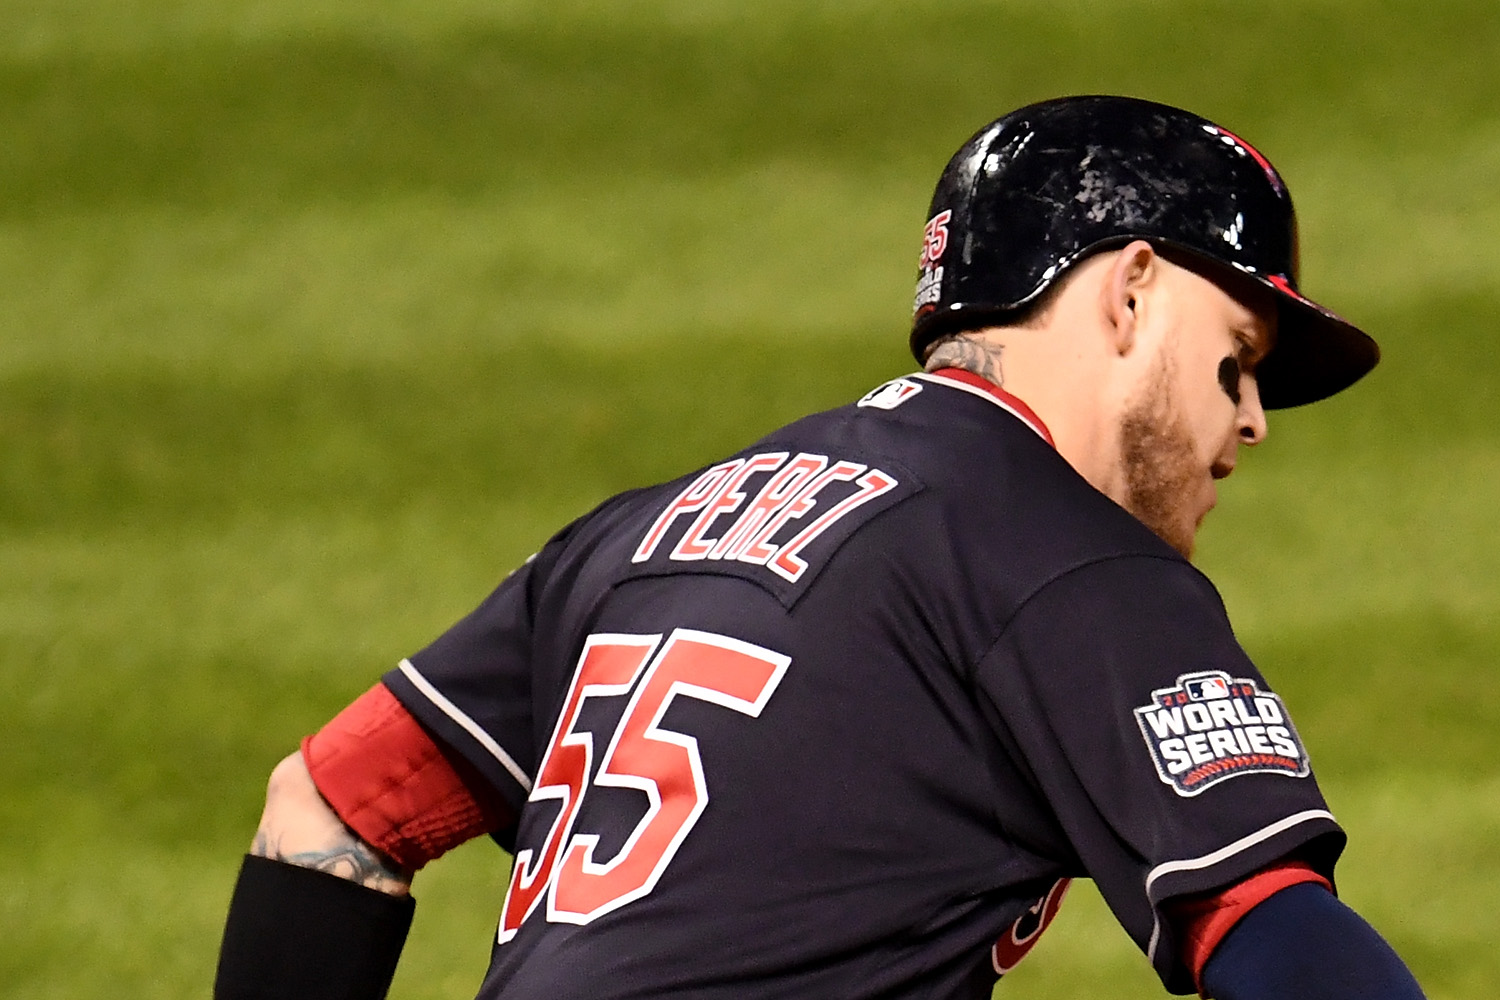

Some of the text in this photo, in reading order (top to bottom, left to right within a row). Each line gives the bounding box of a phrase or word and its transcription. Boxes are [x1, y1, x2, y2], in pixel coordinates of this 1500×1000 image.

[918, 209, 952, 270] 55
[631, 452, 898, 583] PEREZ
[1145, 697, 1283, 739] WORLD
[1159, 726, 1299, 775] SERIES
[498, 627, 792, 944] 55
